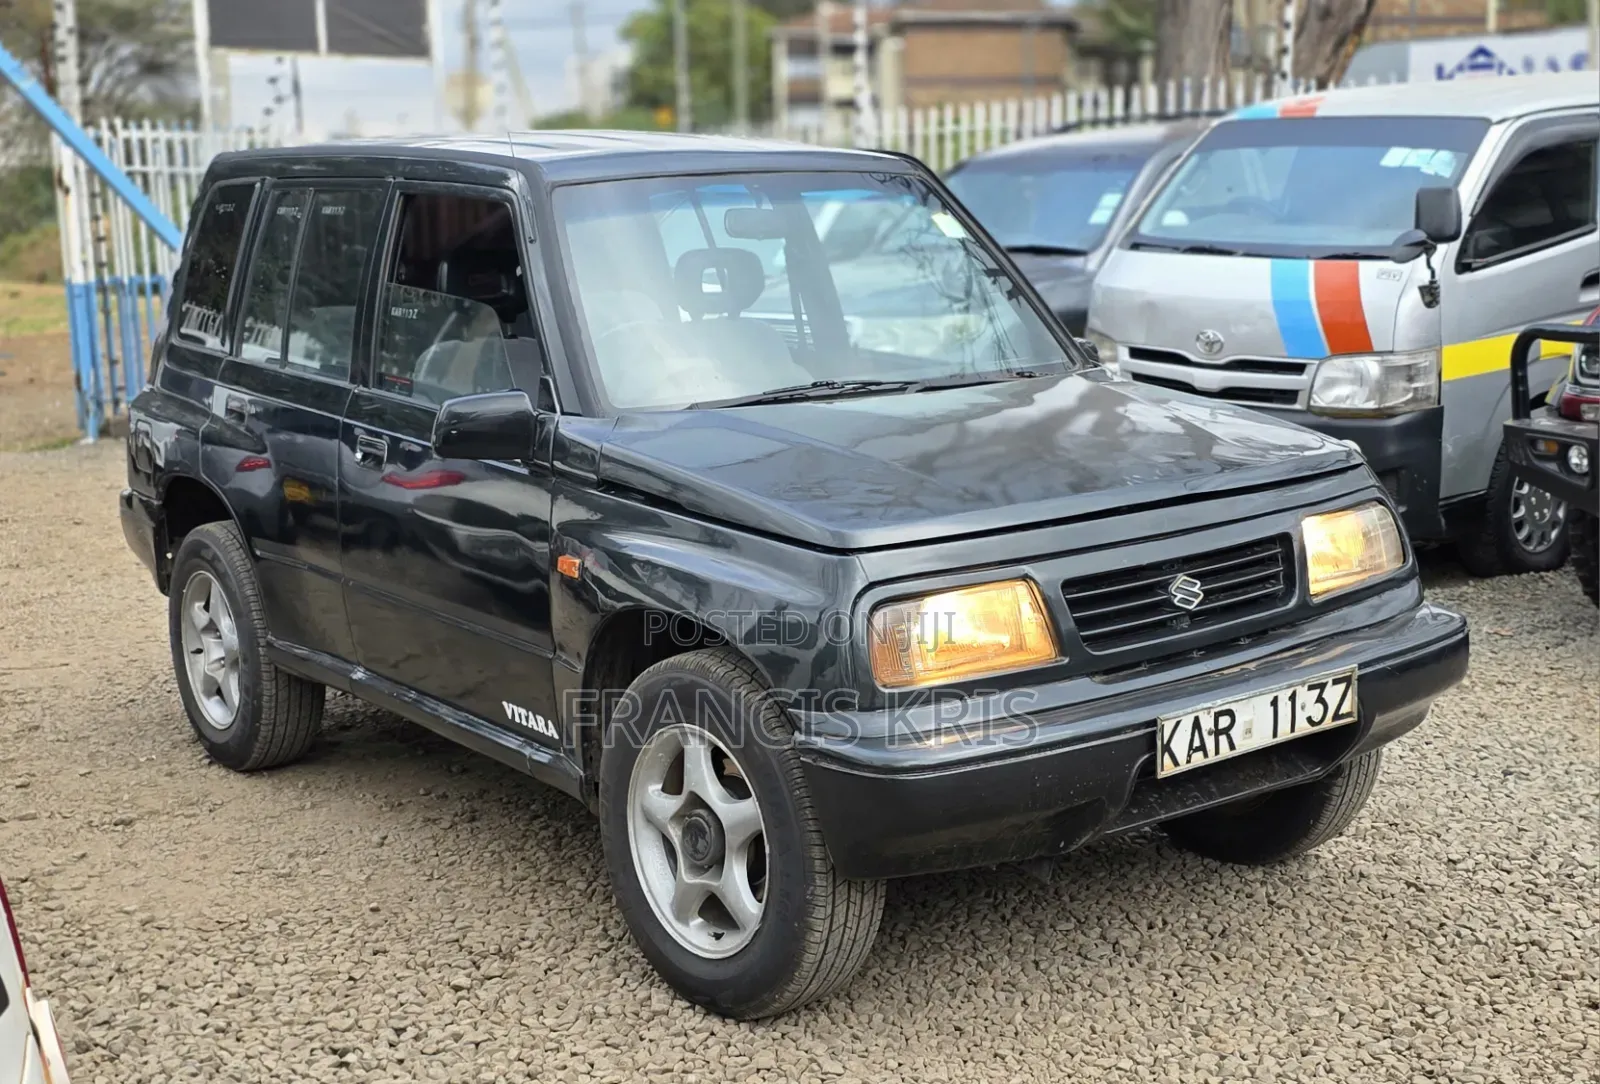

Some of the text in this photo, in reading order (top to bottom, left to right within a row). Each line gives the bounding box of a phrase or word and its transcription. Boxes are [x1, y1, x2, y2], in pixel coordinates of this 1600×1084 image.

[501, 700, 560, 740] VITARA
[1161, 675, 1355, 772] KAR 113Z
